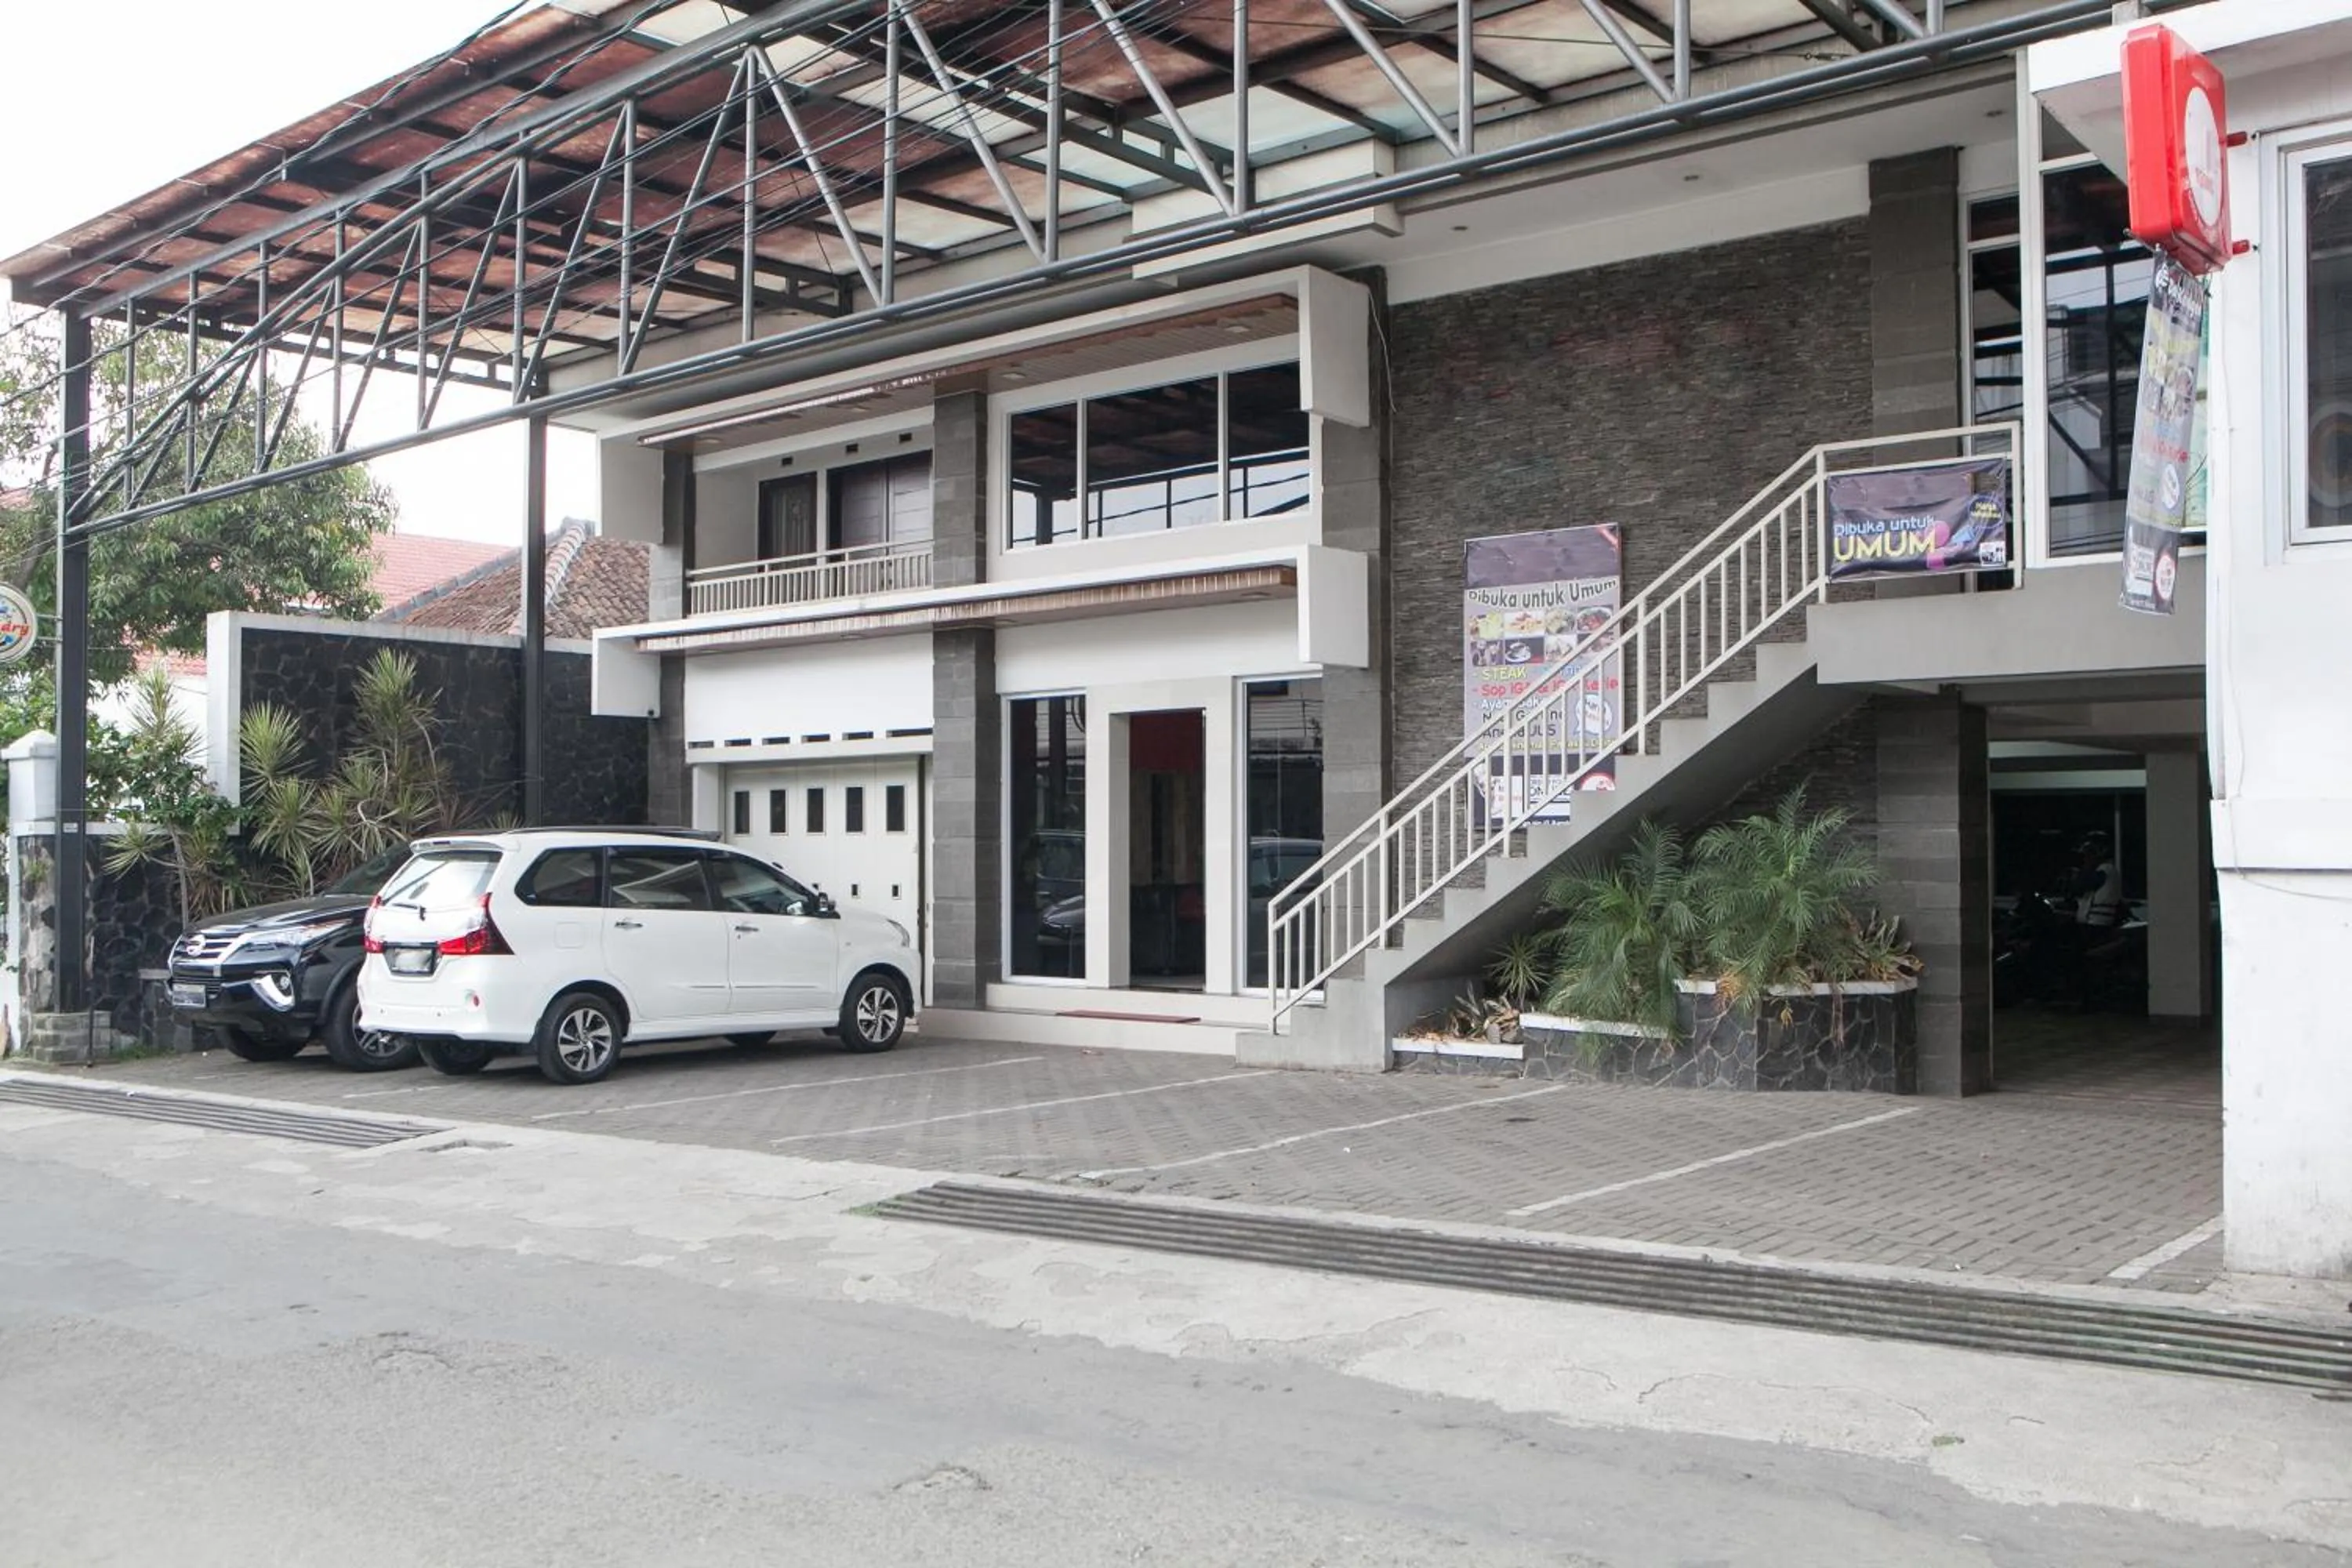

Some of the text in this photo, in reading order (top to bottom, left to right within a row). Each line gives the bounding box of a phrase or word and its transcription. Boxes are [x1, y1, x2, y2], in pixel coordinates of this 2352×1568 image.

[1834, 515, 1934, 535] Dibuka untuk
[1834, 529, 1936, 561] UMUM
[1468, 580, 1616, 608] Dibuka untuk Umum
[1482, 667, 1526, 681] STEAK
[1480, 684, 1506, 697] Sop
